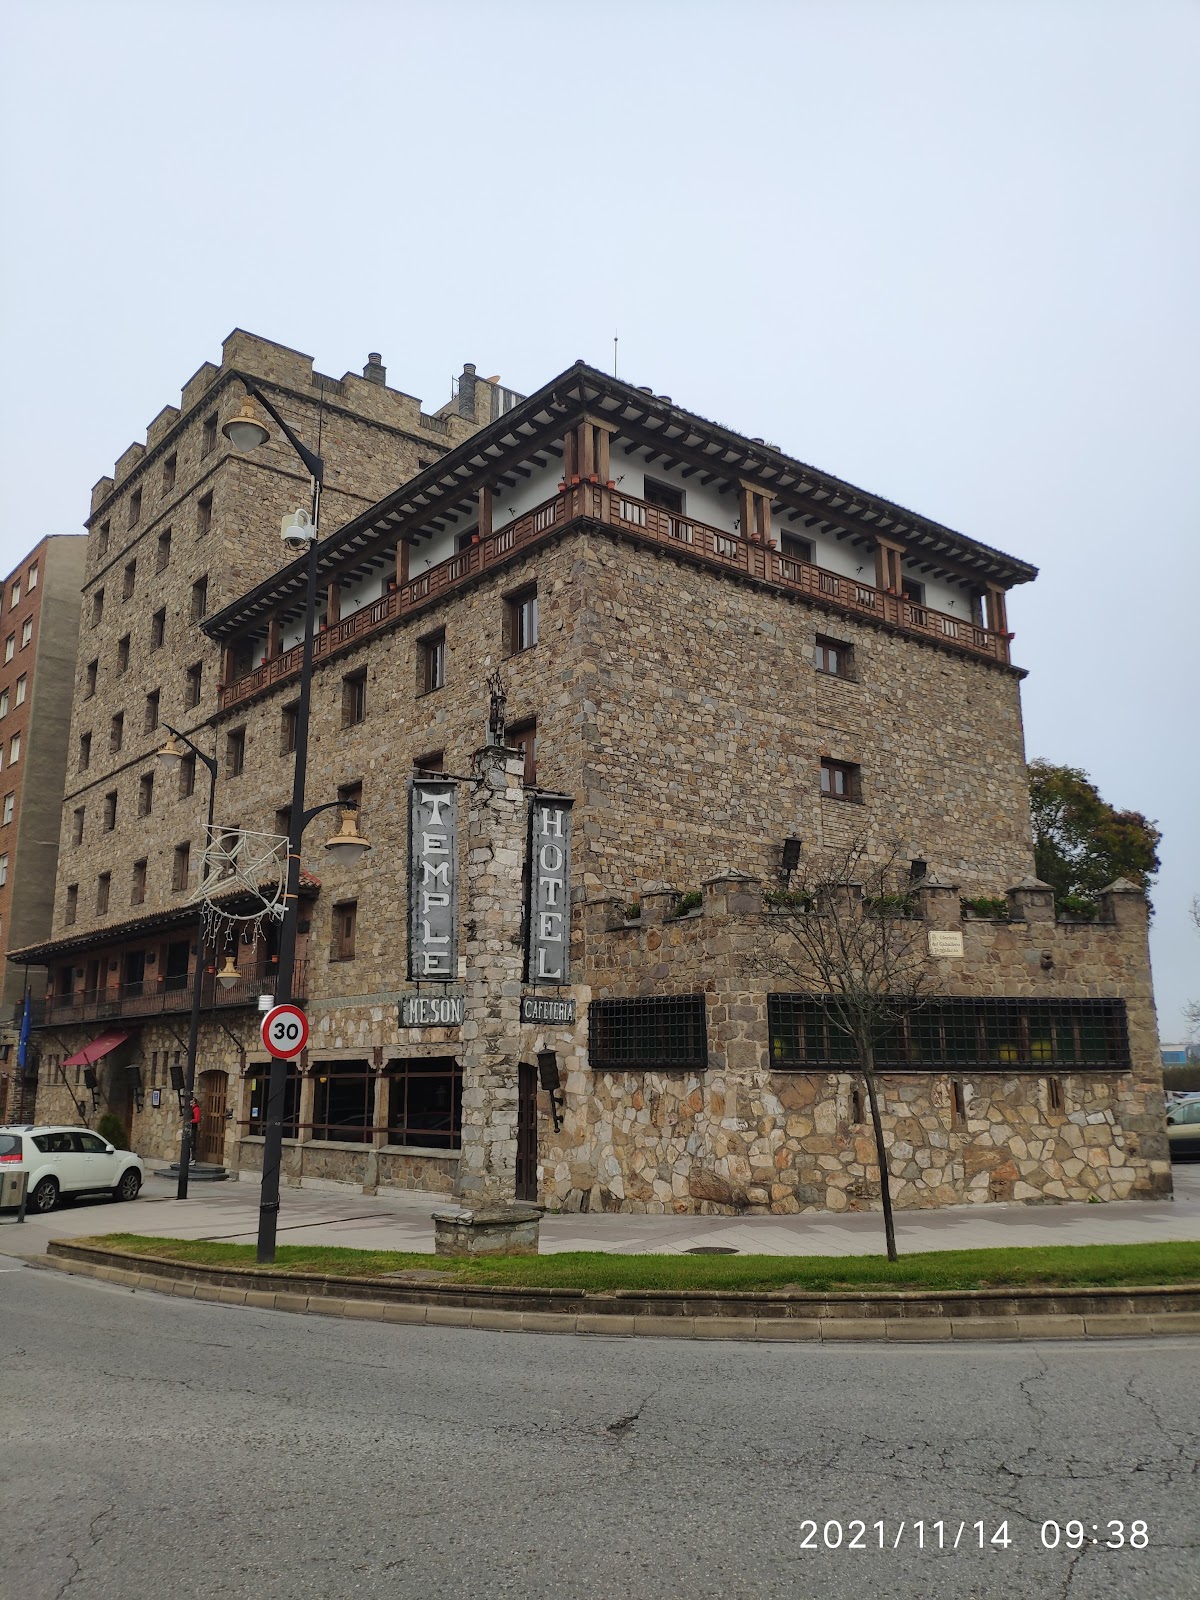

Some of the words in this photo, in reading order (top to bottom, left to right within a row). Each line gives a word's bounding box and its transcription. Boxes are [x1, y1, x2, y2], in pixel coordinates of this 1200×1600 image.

[421, 792, 450, 975] TEMPLE
[537, 807, 564, 979] HOTEL
[273, 1022, 299, 1040] 30
[524, 1001, 573, 1021] CAFETERIA
